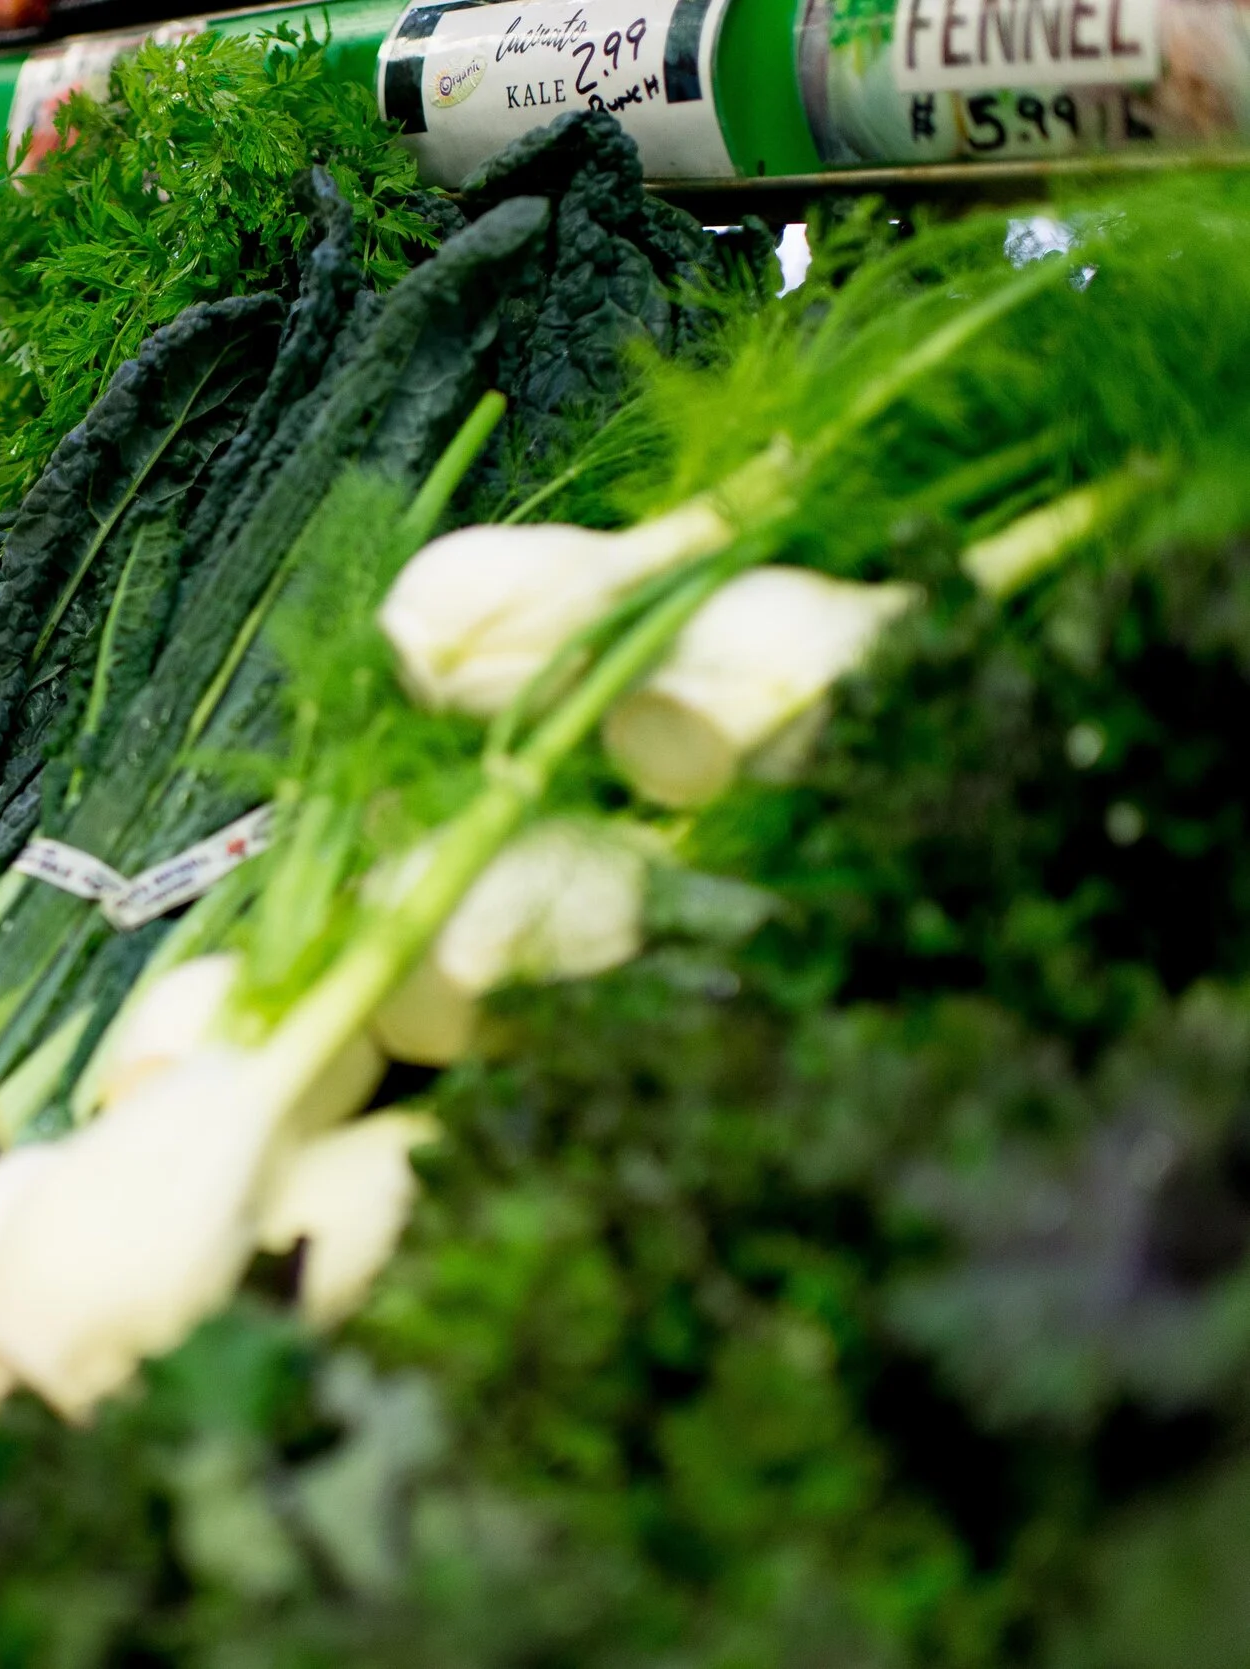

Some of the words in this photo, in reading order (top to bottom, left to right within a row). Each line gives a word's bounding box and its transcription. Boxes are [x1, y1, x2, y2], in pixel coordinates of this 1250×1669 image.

[571, 17, 647, 95] 2.99
[905, 0, 1143, 70] FENNEL
[506, 79, 567, 109] KALE
